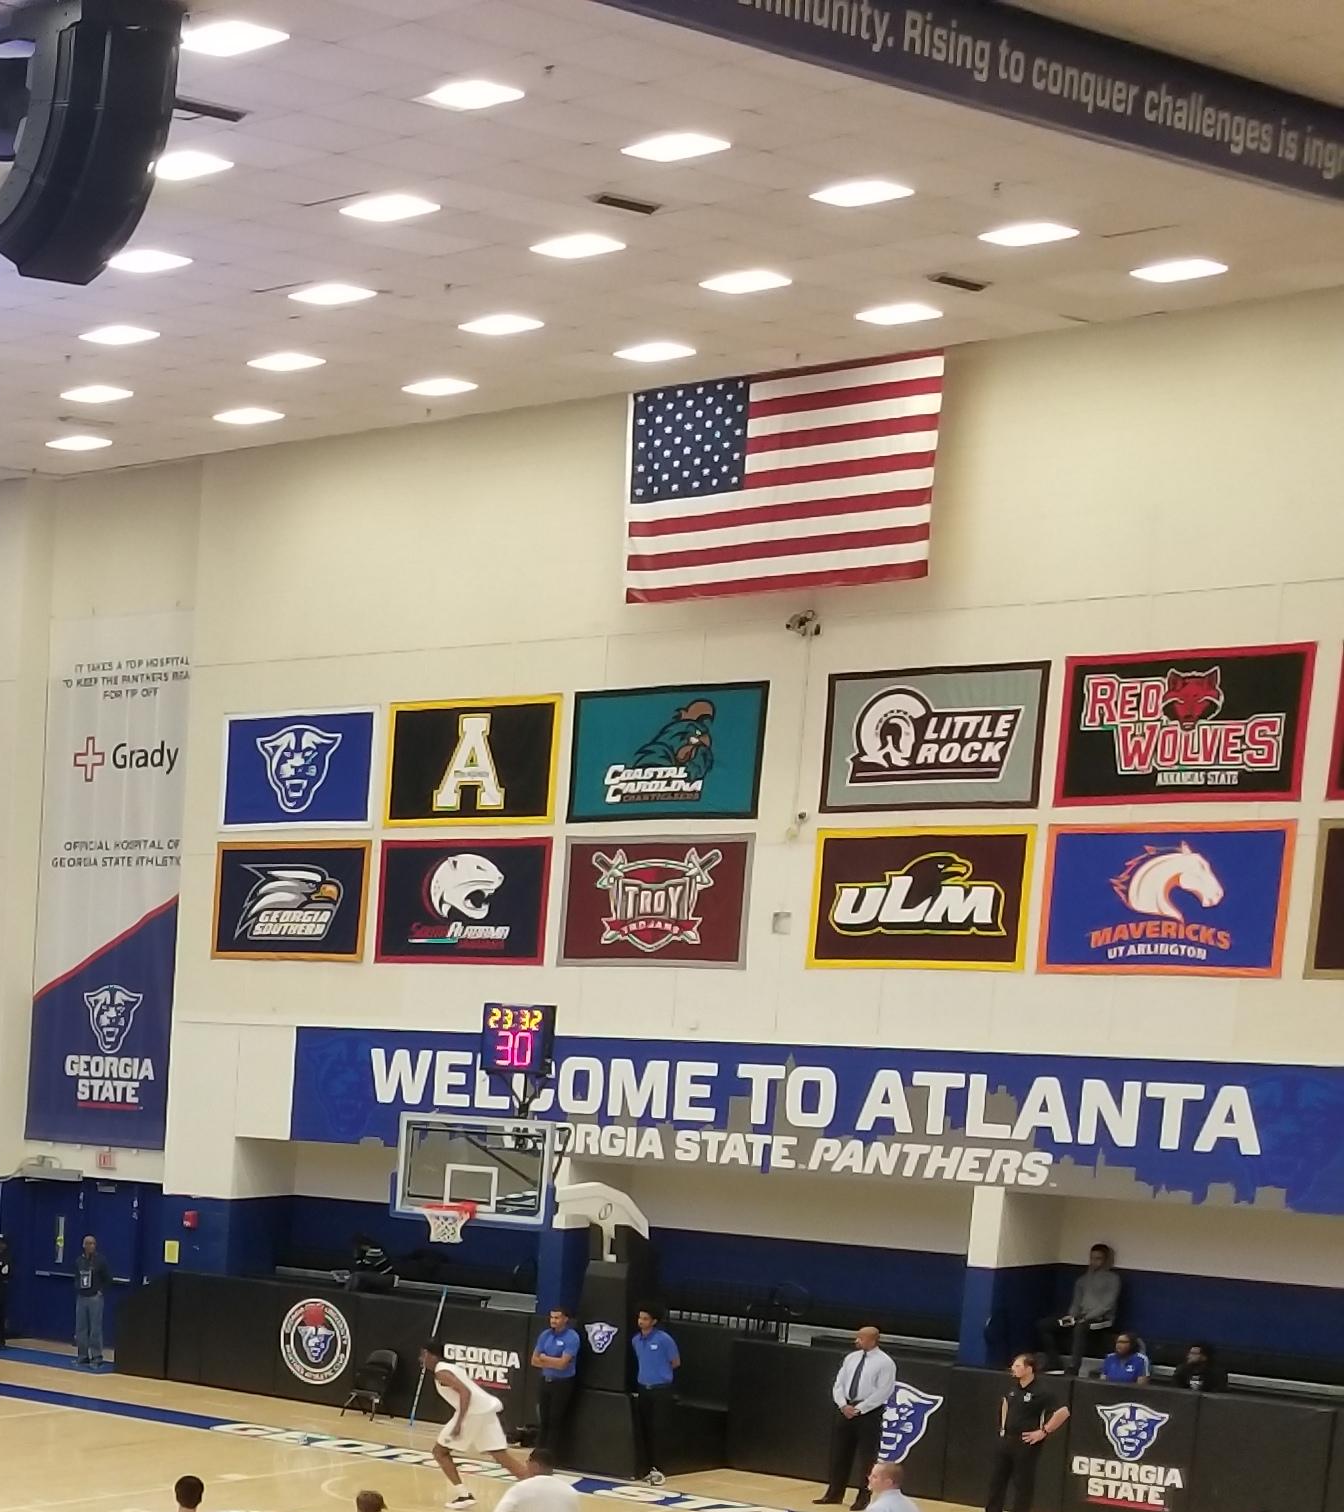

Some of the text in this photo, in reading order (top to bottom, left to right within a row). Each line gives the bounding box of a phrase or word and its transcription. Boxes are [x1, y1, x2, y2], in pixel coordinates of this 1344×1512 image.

[903, 9, 991, 83] Rising
[998, 38, 1026, 84] to
[1032, 56, 1140, 114] conquer
[1144, 84, 1272, 155] challenges
[1278, 117, 1298, 161] is
[87, 661, 113, 672] TAKES
[116, 661, 123, 670] A
[126, 659, 144, 669] TOP
[146, 656, 190, 668] HOSPITAL
[101, 675, 119, 686] THE
[121, 671, 169, 684] PANTHERS
[103, 690, 123, 700] FOR
[141, 687, 160, 698] OFF
[1083, 674, 1164, 729] RED
[924, 709, 1015, 739] LITTLE
[916, 740, 1006, 765] ROCK
[1118, 714, 1287, 774] WOLVES
[112, 740, 180, 775] Grady
[432, 712, 505, 811] A
[604, 764, 688, 785] COASTAL
[1207, 771, 1239, 785] STATE
[605, 779, 703, 803] CAROLINA
[64, 840, 110, 851] OFFICIAL
[113, 839, 160, 851] HOSPITAL
[51, 856, 133, 868] GEORGIA STATE
[624, 885, 683, 920] TROY
[831, 876, 995, 927] ULM
[252, 923, 327, 936] SOUTHERN
[257, 910, 331, 923] GEORGIA
[1090, 920, 1231, 950] MAVERICKS
[1107, 943, 1207, 960] UT ARLINGTON
[487, 1007, 543, 1031] 23:32
[495, 1031, 532, 1066] 30
[64, 1054, 155, 1080] GEORGIA
[77, 1078, 140, 1104] STATE
[736, 1062, 837, 1130] TO
[855, 1068, 1263, 1157] ATLANTA
[674, 1130, 1054, 1188] STATE PANTHERS
[443, 1343, 521, 1369] GEORGIA
[1072, 1455, 1184, 1490] GEORGIA
[1087, 1477, 1167, 1506] STATE
